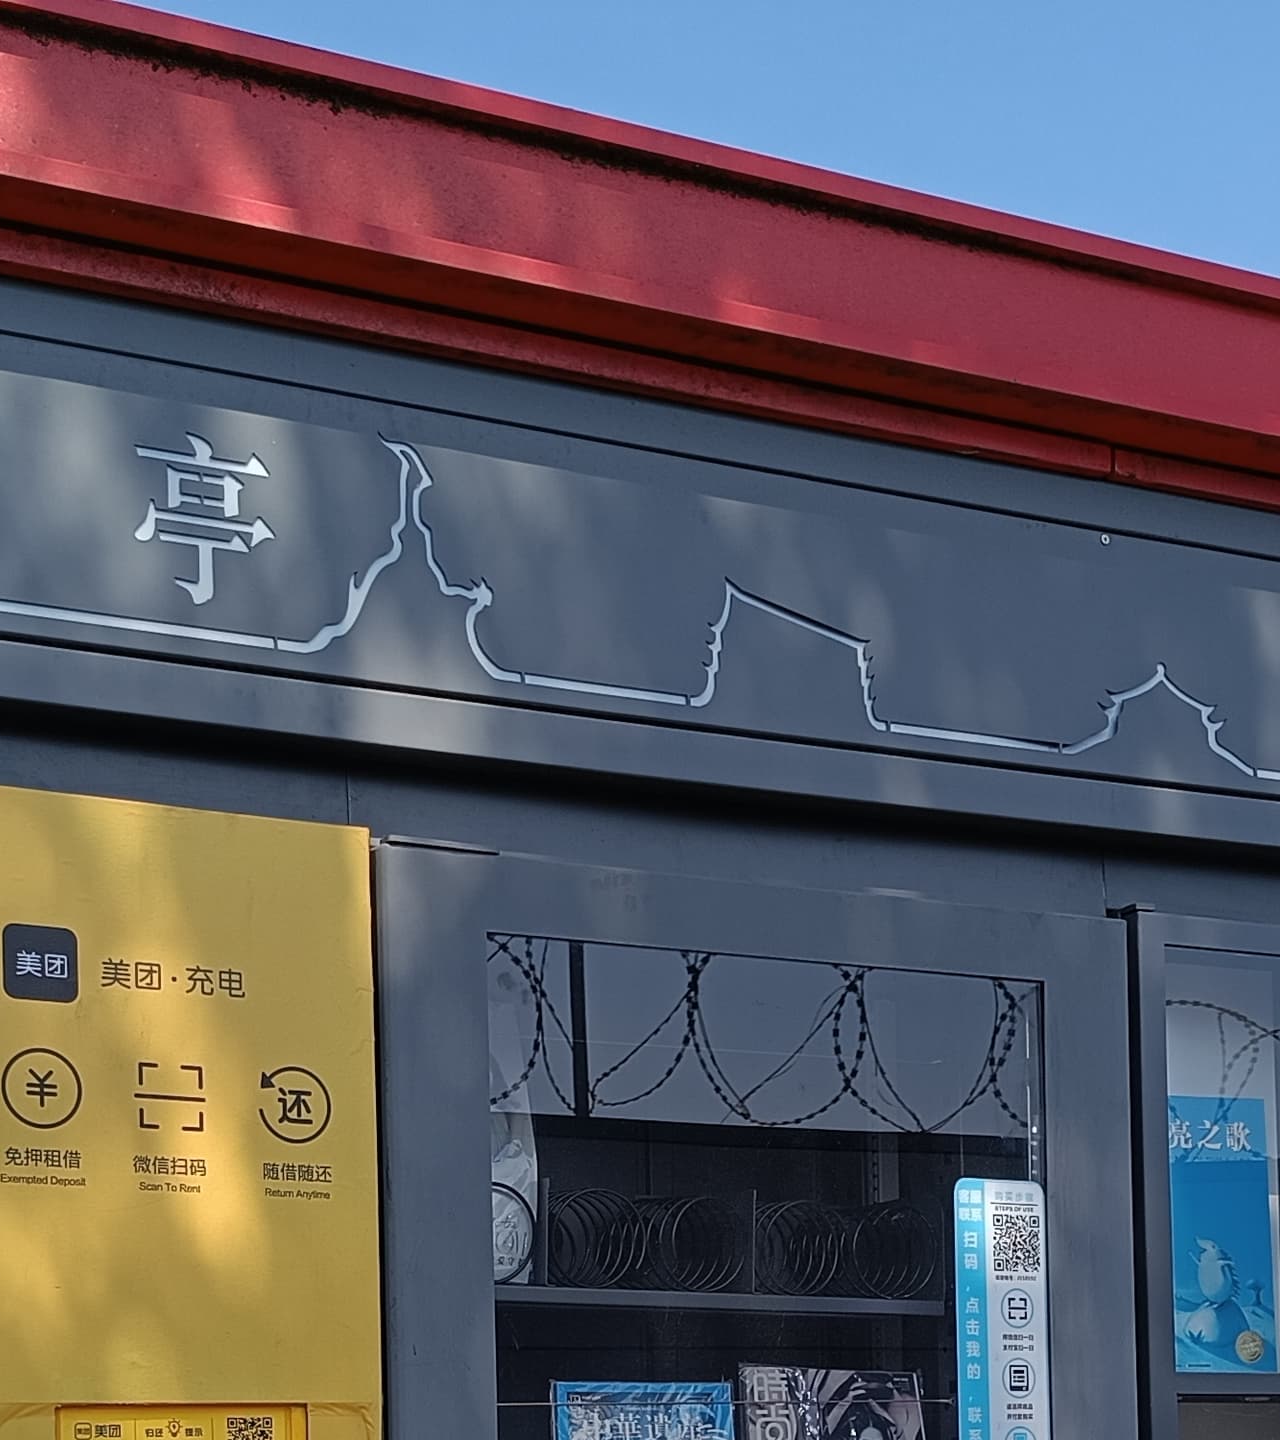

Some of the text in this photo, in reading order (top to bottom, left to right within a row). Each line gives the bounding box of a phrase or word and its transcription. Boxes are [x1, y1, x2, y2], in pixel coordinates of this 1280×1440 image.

[15, 951, 68, 978] 美团
[100, 958, 246, 998] 美团·充电
[3, 1146, 82, 1170] 免押租借
[132, 1154, 207, 1178] 微信扫码
[0, 1173, 87, 1188] Exempted Deposit
[262, 1161, 333, 1185] 随借随还
[138, 1181, 201, 1194] Scan To Rent
[264, 1187, 331, 1200] Return Anytime
[94, 1423, 122, 1439] 美团
